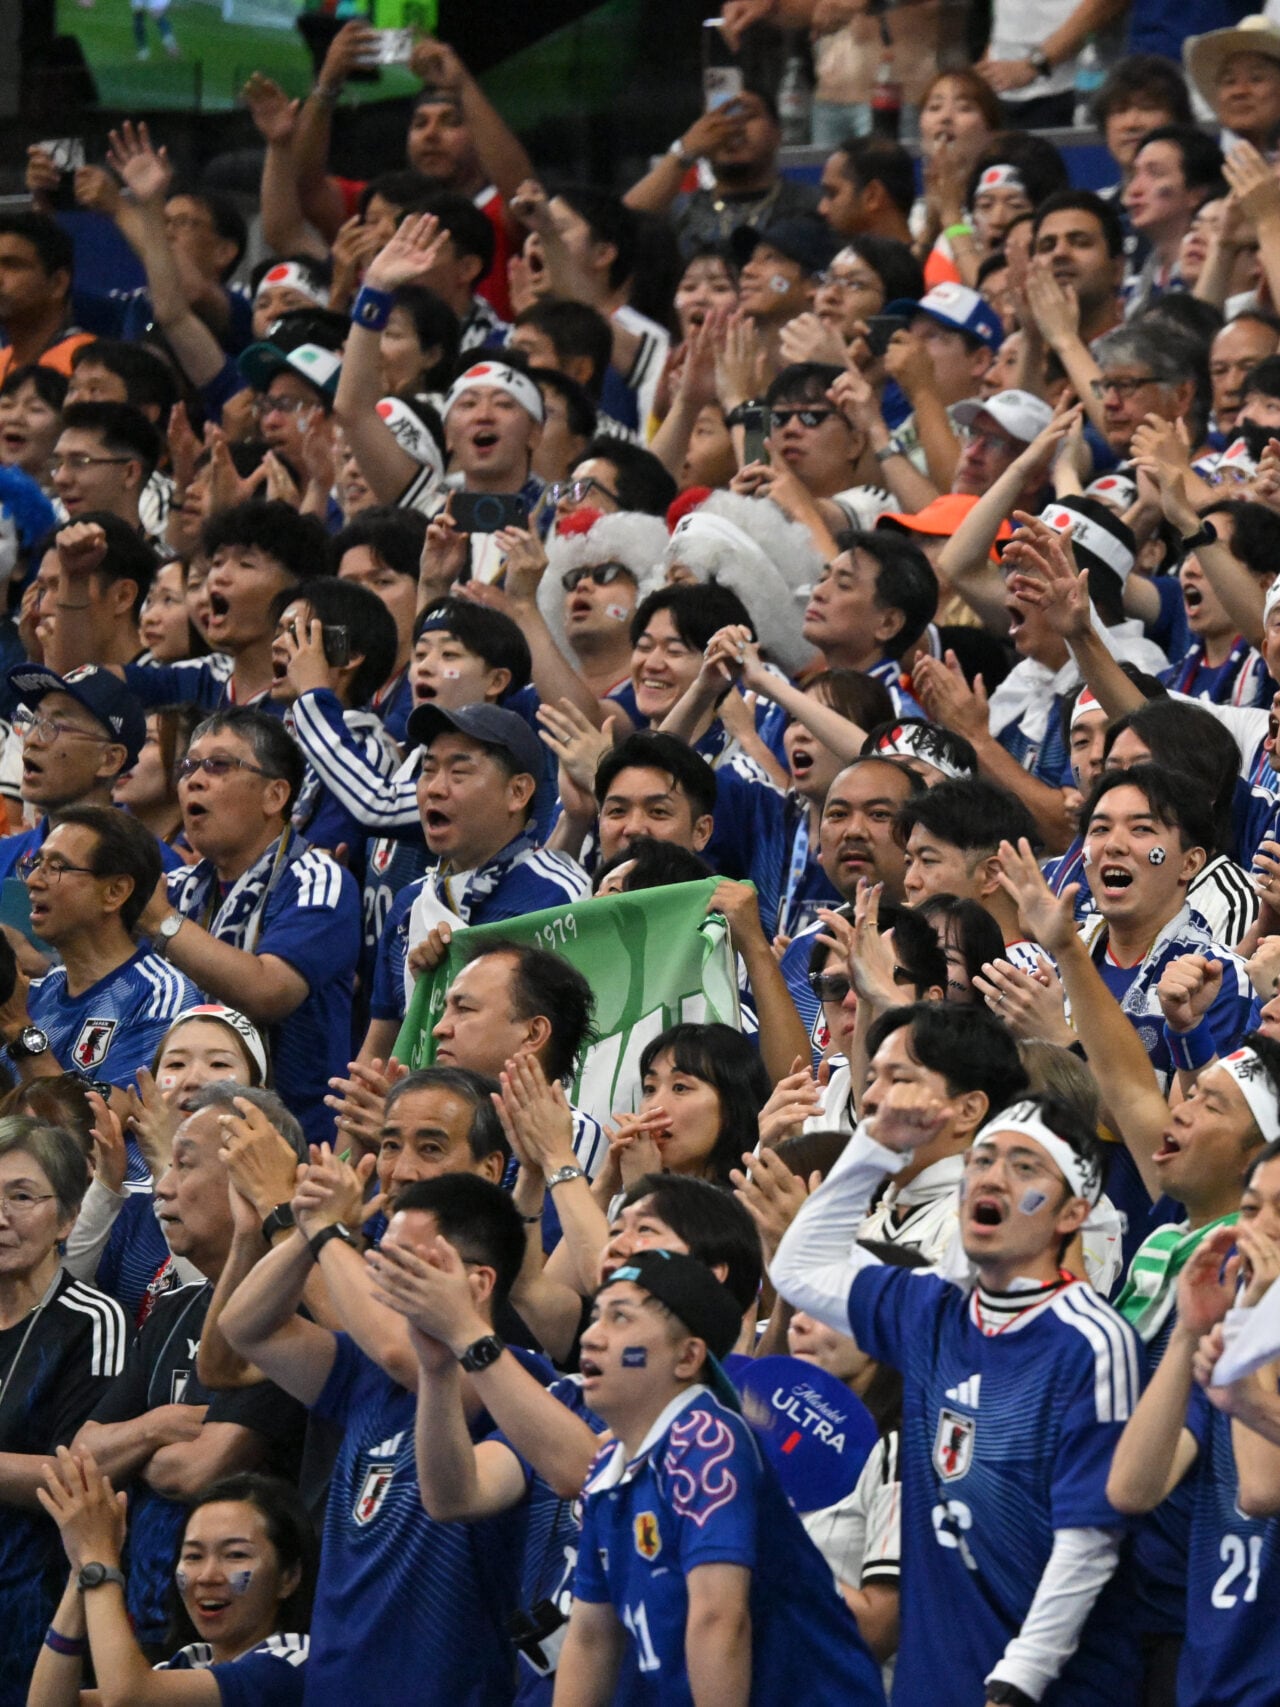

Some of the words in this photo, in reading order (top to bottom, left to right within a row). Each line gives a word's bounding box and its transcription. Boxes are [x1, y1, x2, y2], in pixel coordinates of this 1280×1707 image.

[535, 912, 577, 950] 1979
[771, 1386, 846, 1454] ULTRA
[1211, 1534, 1264, 1609] 21
